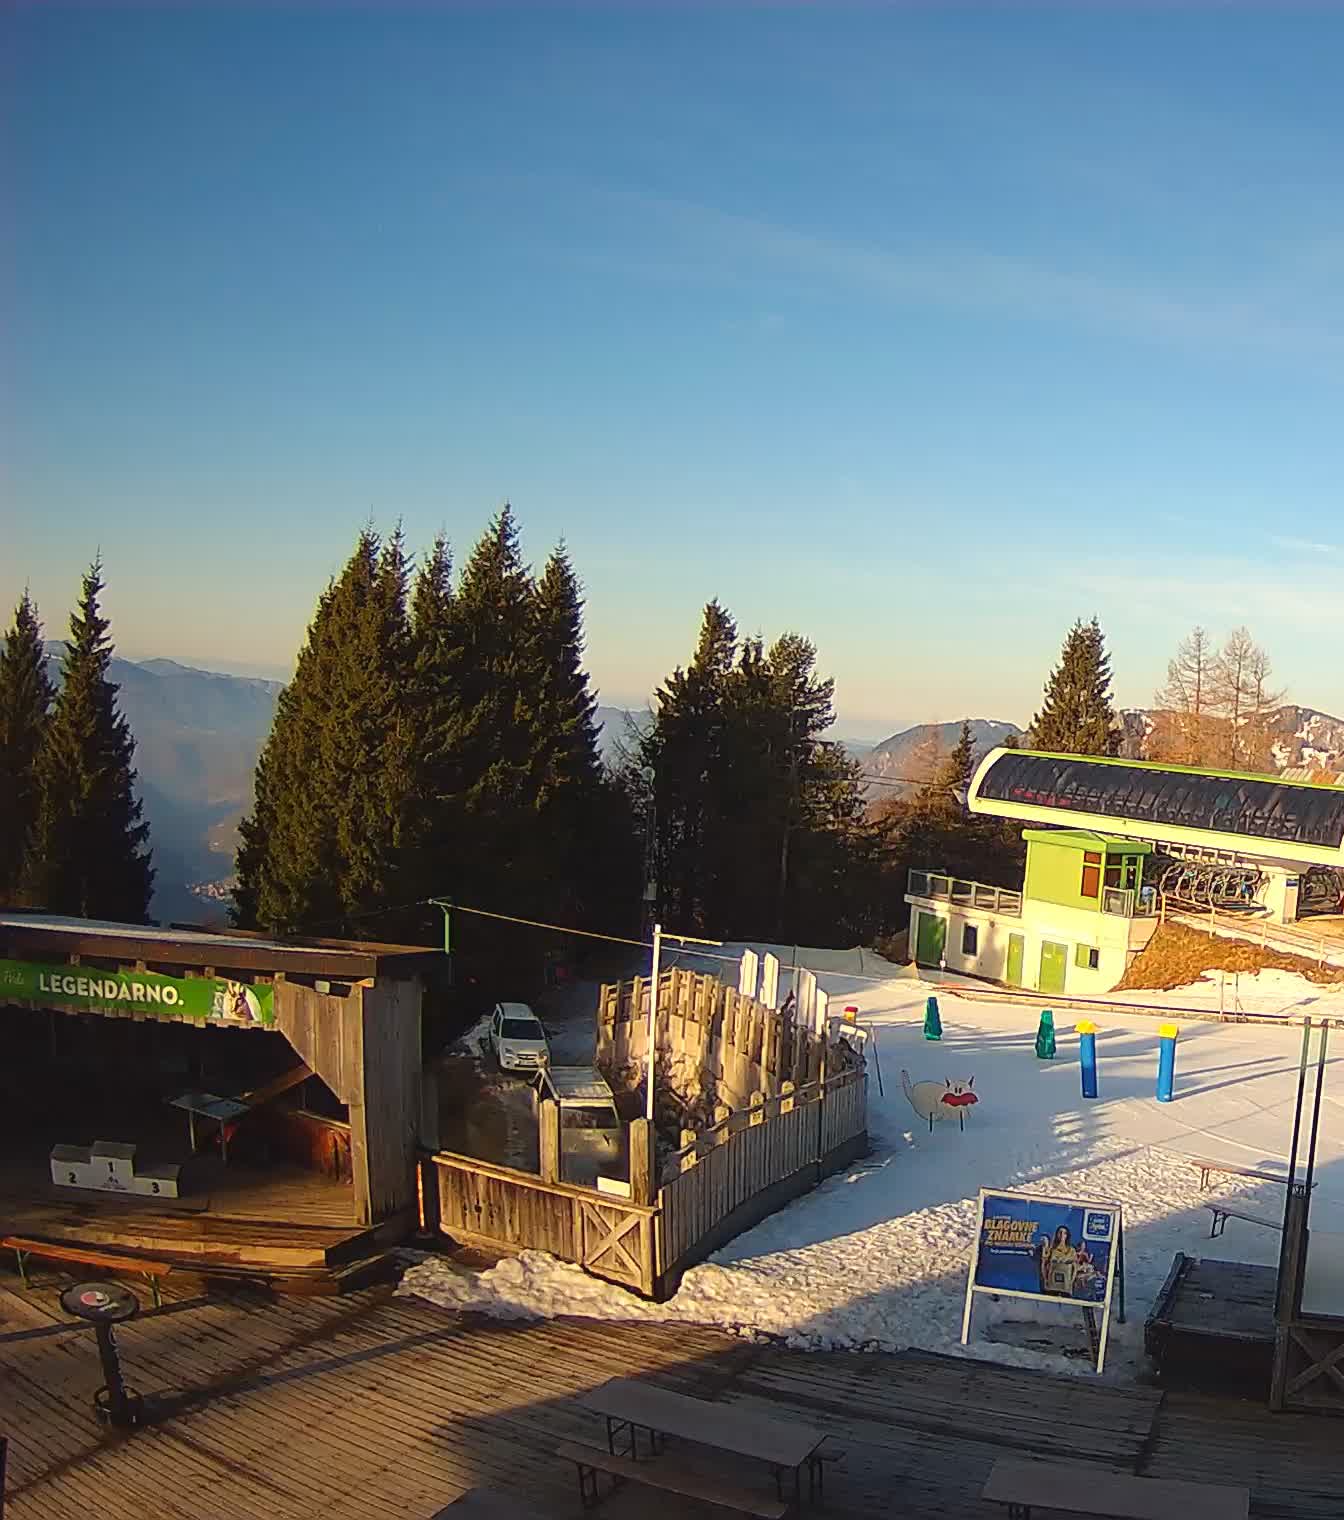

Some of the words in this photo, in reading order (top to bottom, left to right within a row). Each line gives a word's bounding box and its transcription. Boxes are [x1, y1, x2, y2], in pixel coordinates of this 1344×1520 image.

[39, 972, 185, 1006] LEGENDARNO.
[107, 1161, 114, 1173] 1
[68, 1171, 77, 1184] 2
[151, 1181, 160, 1194] 3
[986, 1229, 1033, 1243] ZNAMKE
